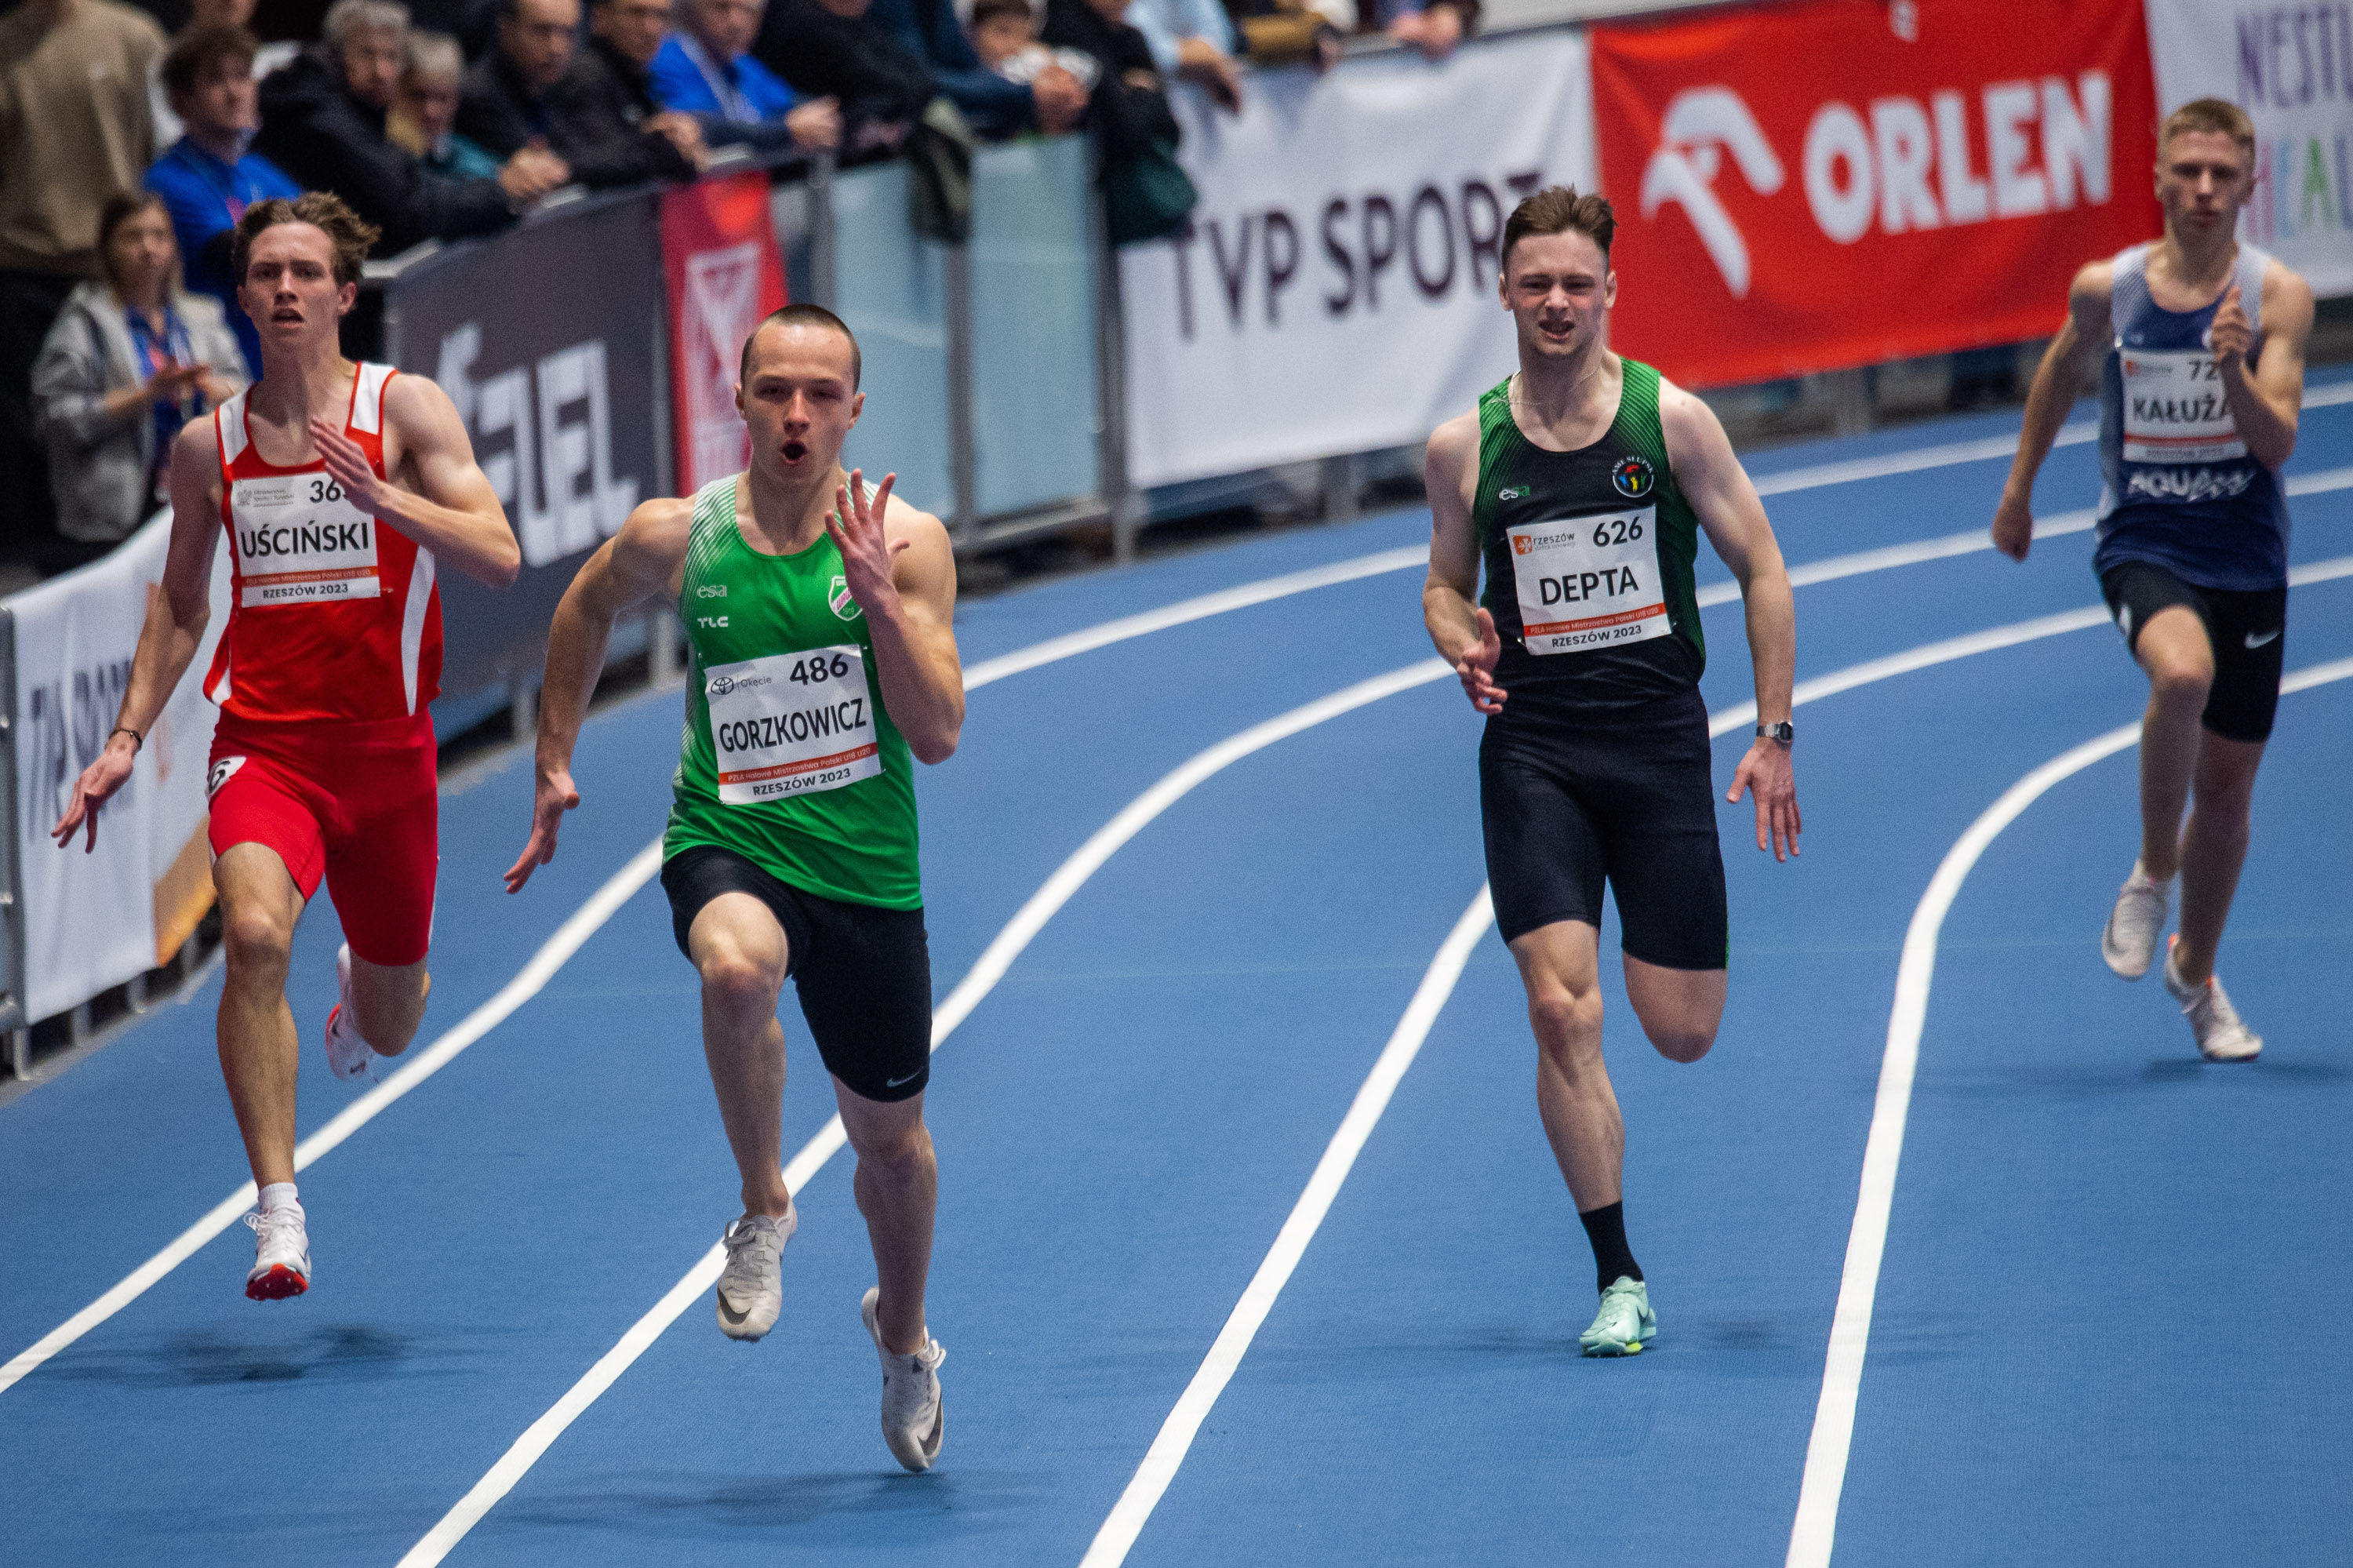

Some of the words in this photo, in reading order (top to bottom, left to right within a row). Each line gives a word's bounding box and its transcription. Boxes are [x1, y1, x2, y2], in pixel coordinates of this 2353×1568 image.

[1804, 71, 2111, 243] ORLEN
[1321, 171, 1543, 315] SPOR
[309, 480, 351, 504] 36
[241, 520, 369, 558] UŚCIŃSKI
[1533, 533, 1575, 545] rzeszów
[1593, 516, 1643, 548] 626
[263, 584, 316, 599] RZESZÓW
[319, 584, 349, 595] 2023
[697, 584, 728, 598] esa
[1539, 566, 1639, 606] DEPTA
[697, 616, 729, 628] TLC
[1615, 612, 1635, 624] Polski
[1551, 632, 1610, 648] RZESZÓW
[1613, 624, 1642, 639] 2023
[740, 676, 773, 689] Okęcie
[789, 653, 849, 686] 486
[718, 697, 867, 753] GORZKOWICZ
[728, 773, 745, 783] PZLA
[843, 753, 856, 763] U18
[856, 747, 871, 758] U20
[752, 777, 817, 796] RZESZÓW
[819, 767, 852, 784] 2023
